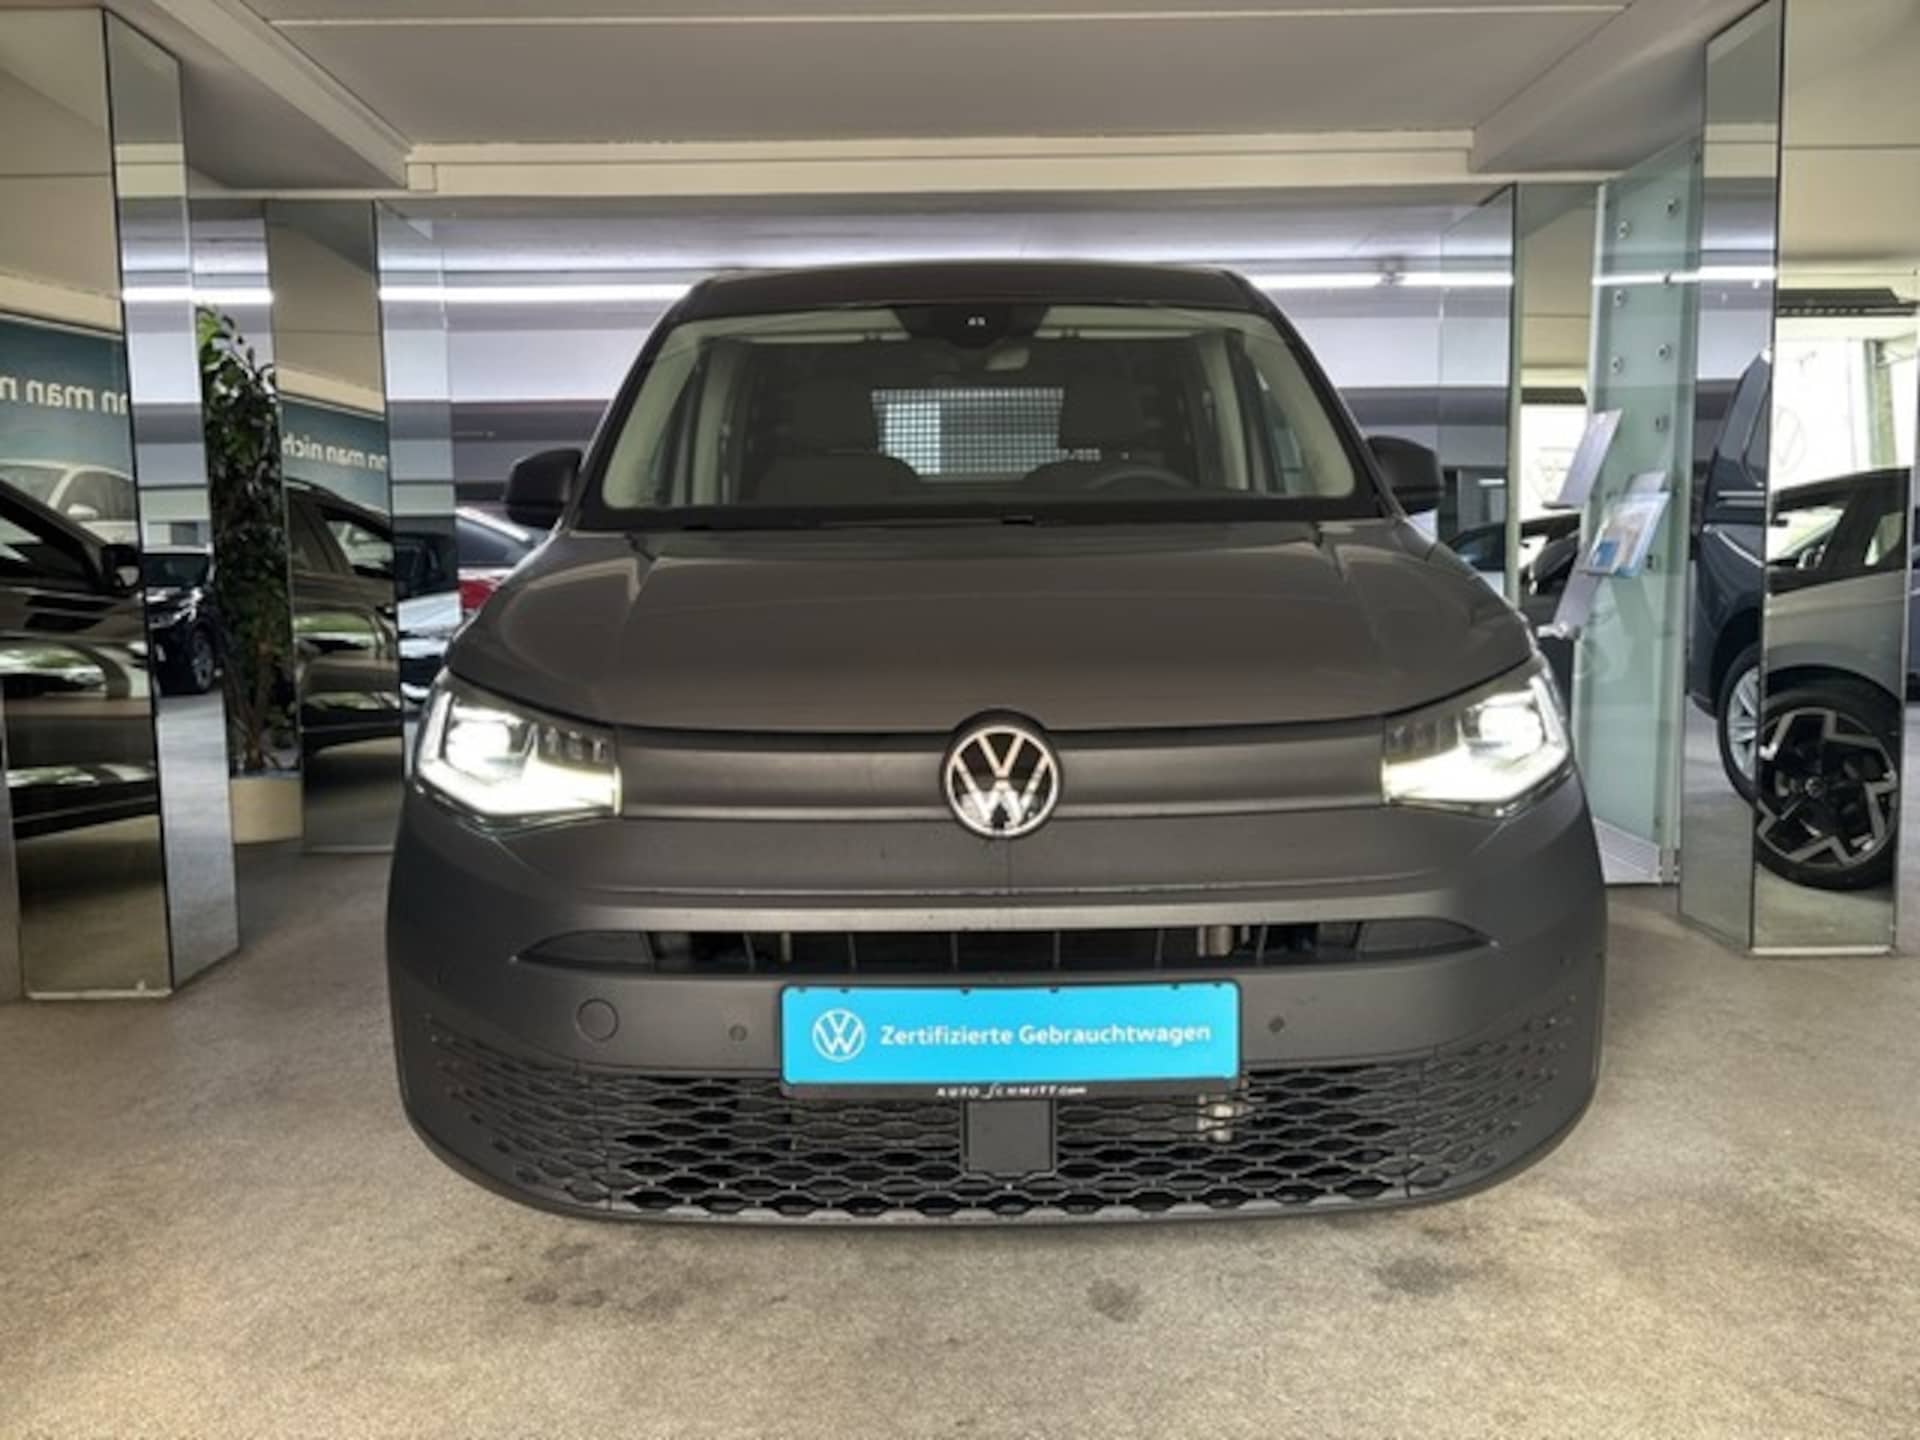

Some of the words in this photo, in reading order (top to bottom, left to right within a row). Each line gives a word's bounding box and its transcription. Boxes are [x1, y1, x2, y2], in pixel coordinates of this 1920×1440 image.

[880, 1025, 1013, 1046] Zertifizierte
[1019, 1024, 1211, 1047] Gebrauchtwagen
[936, 1086, 978, 1098] AUTO
